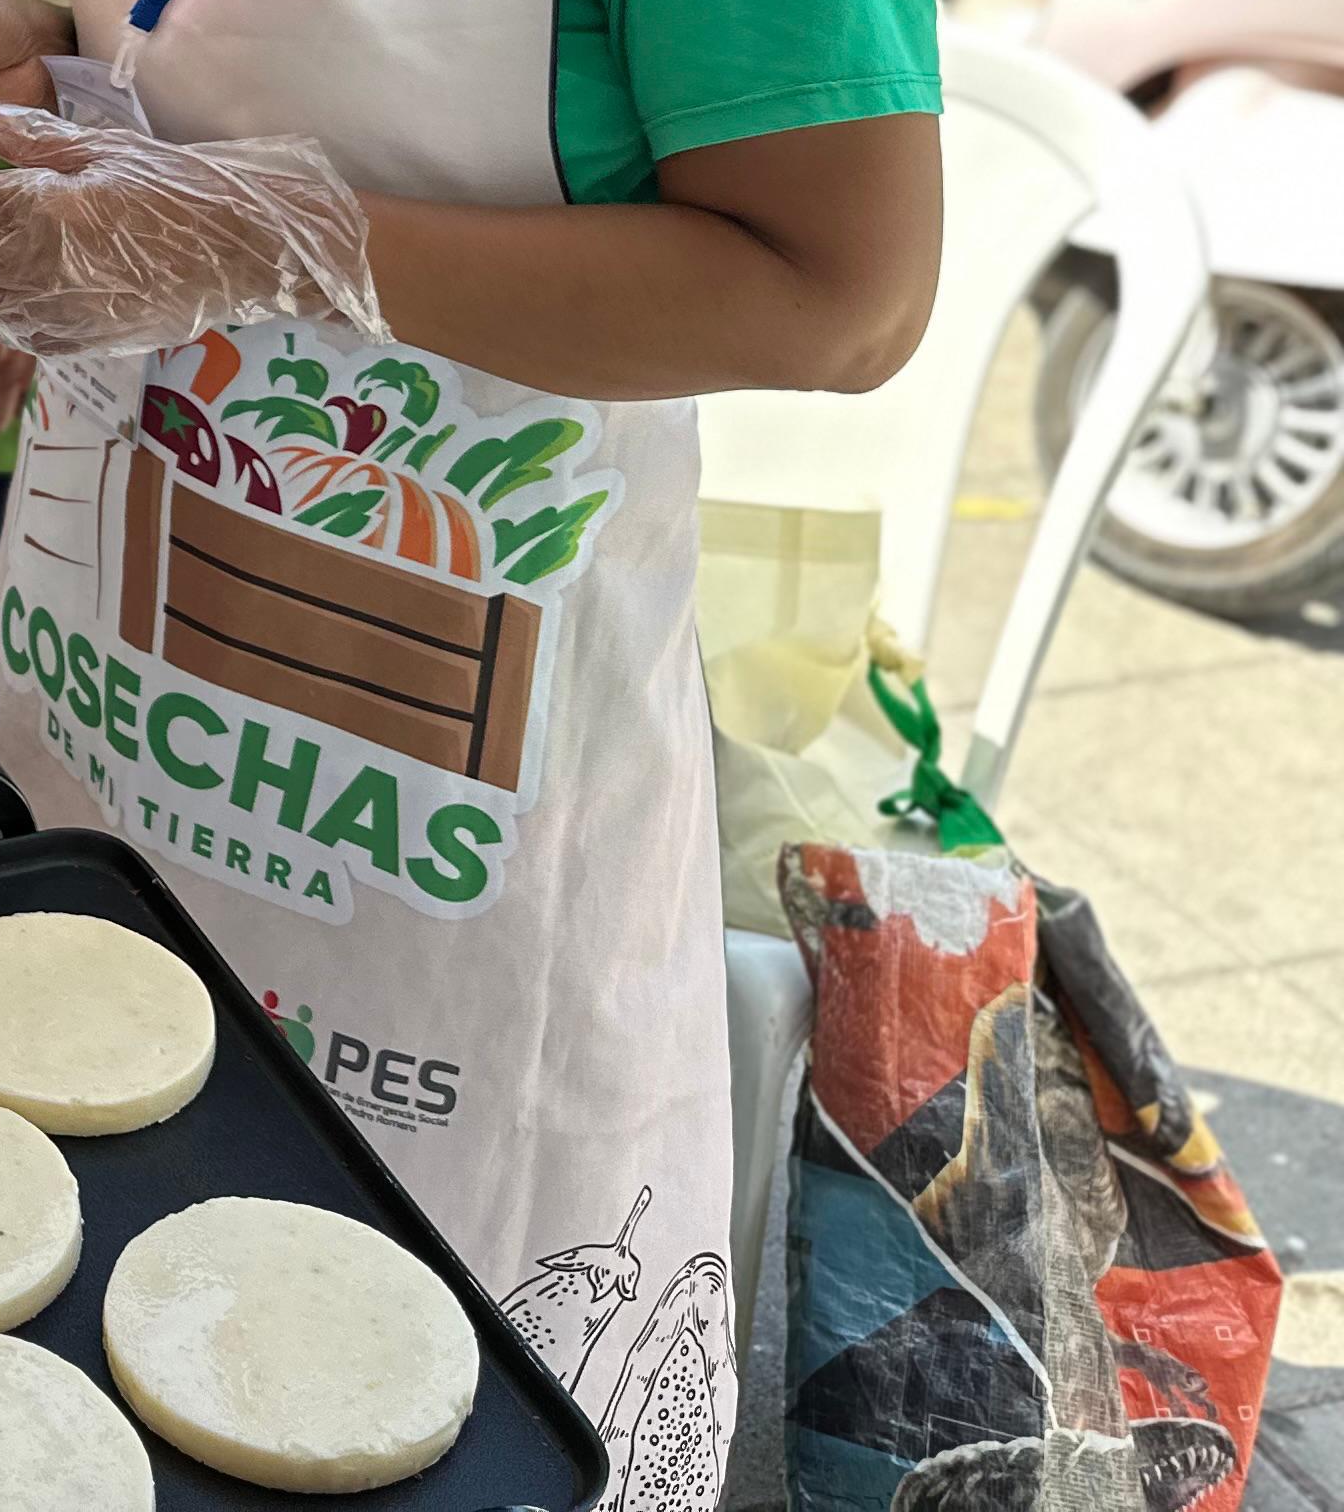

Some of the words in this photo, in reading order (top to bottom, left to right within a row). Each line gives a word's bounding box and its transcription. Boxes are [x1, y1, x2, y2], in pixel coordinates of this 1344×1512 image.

[0, 585, 503, 904] COSECHAS
[47, 709, 74, 762] DE
[89, 753, 115, 807] MI
[137, 796, 335, 906] TIERRA
[324, 1030, 461, 1116] PES
[344, 1103, 374, 1121] Pedro
[376, 1114, 417, 1133] Romero
[418, 1113, 449, 1127] Social
